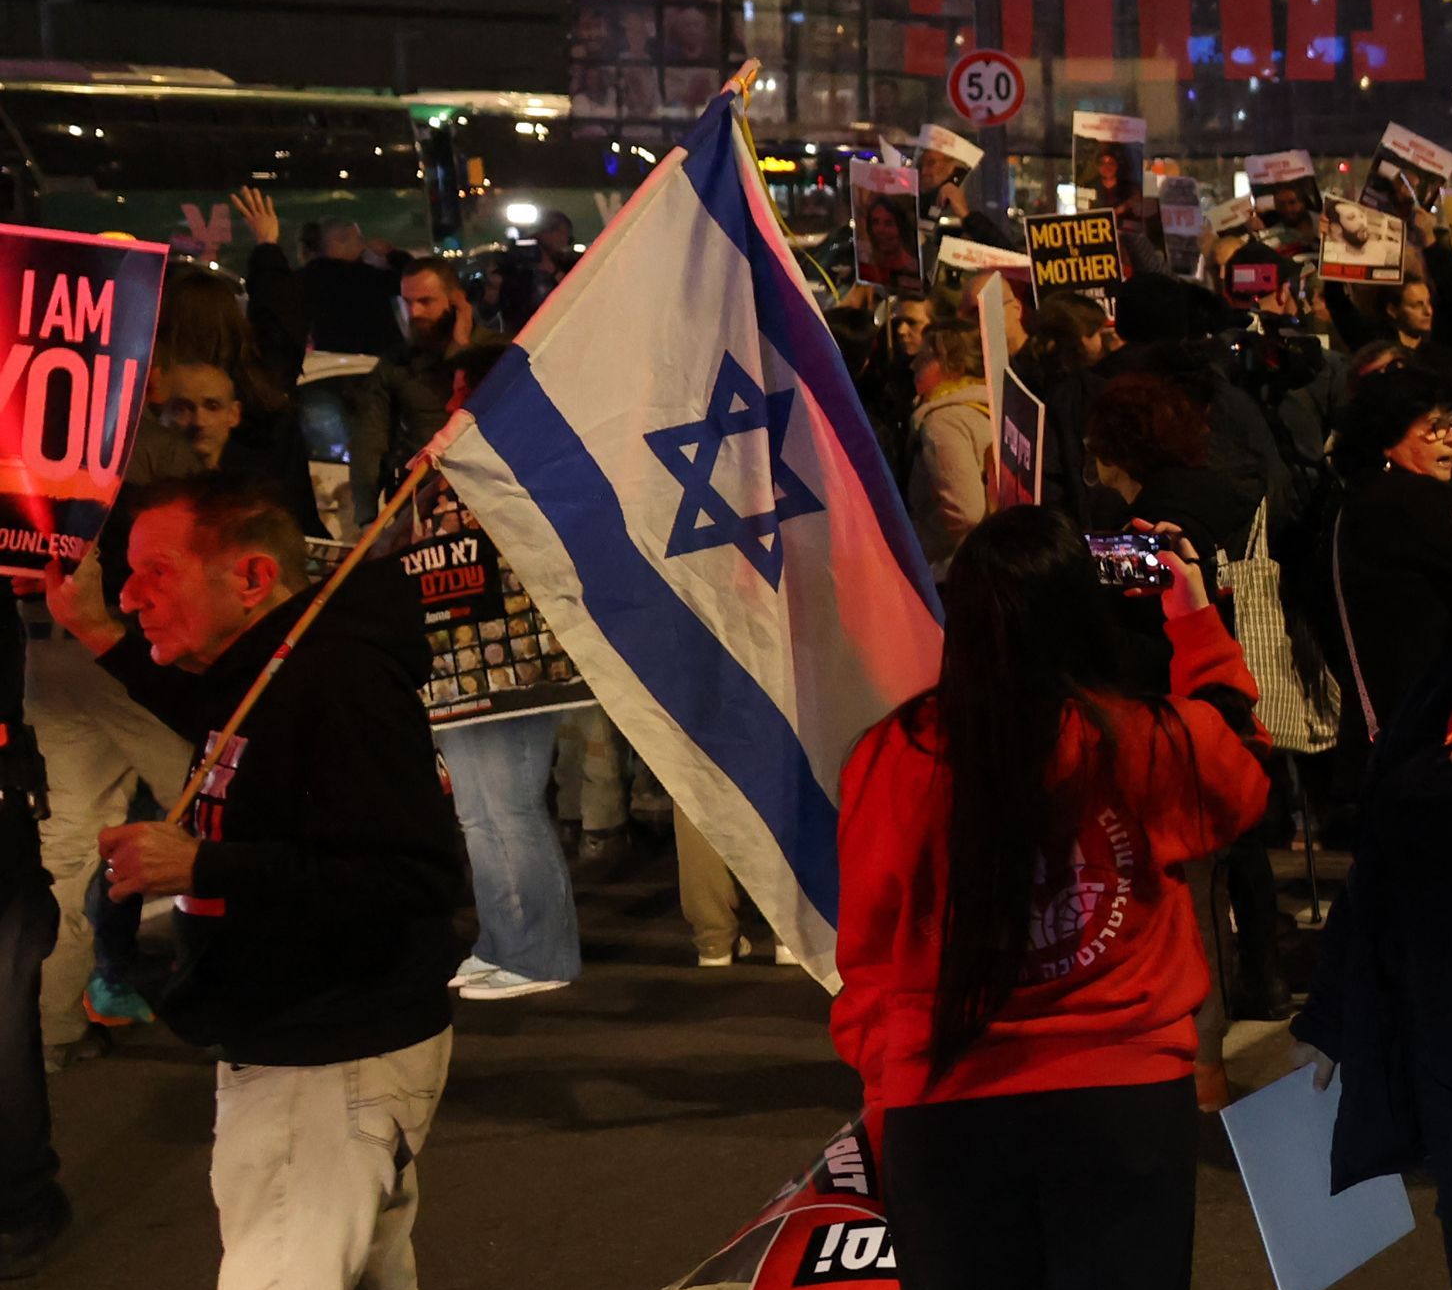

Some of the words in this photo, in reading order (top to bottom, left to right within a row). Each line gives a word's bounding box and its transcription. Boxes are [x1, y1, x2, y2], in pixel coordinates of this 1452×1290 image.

[966, 72, 1011, 102] 5.0
[1030, 217, 1114, 251] MOTHER
[1036, 253, 1119, 286] MOTHER
[18, 268, 36, 338] I
[39, 272, 116, 347] AM
[400, 544, 447, 576] עוצר
[449, 537, 479, 566] לא
[823, 1134, 869, 1196] OUT
